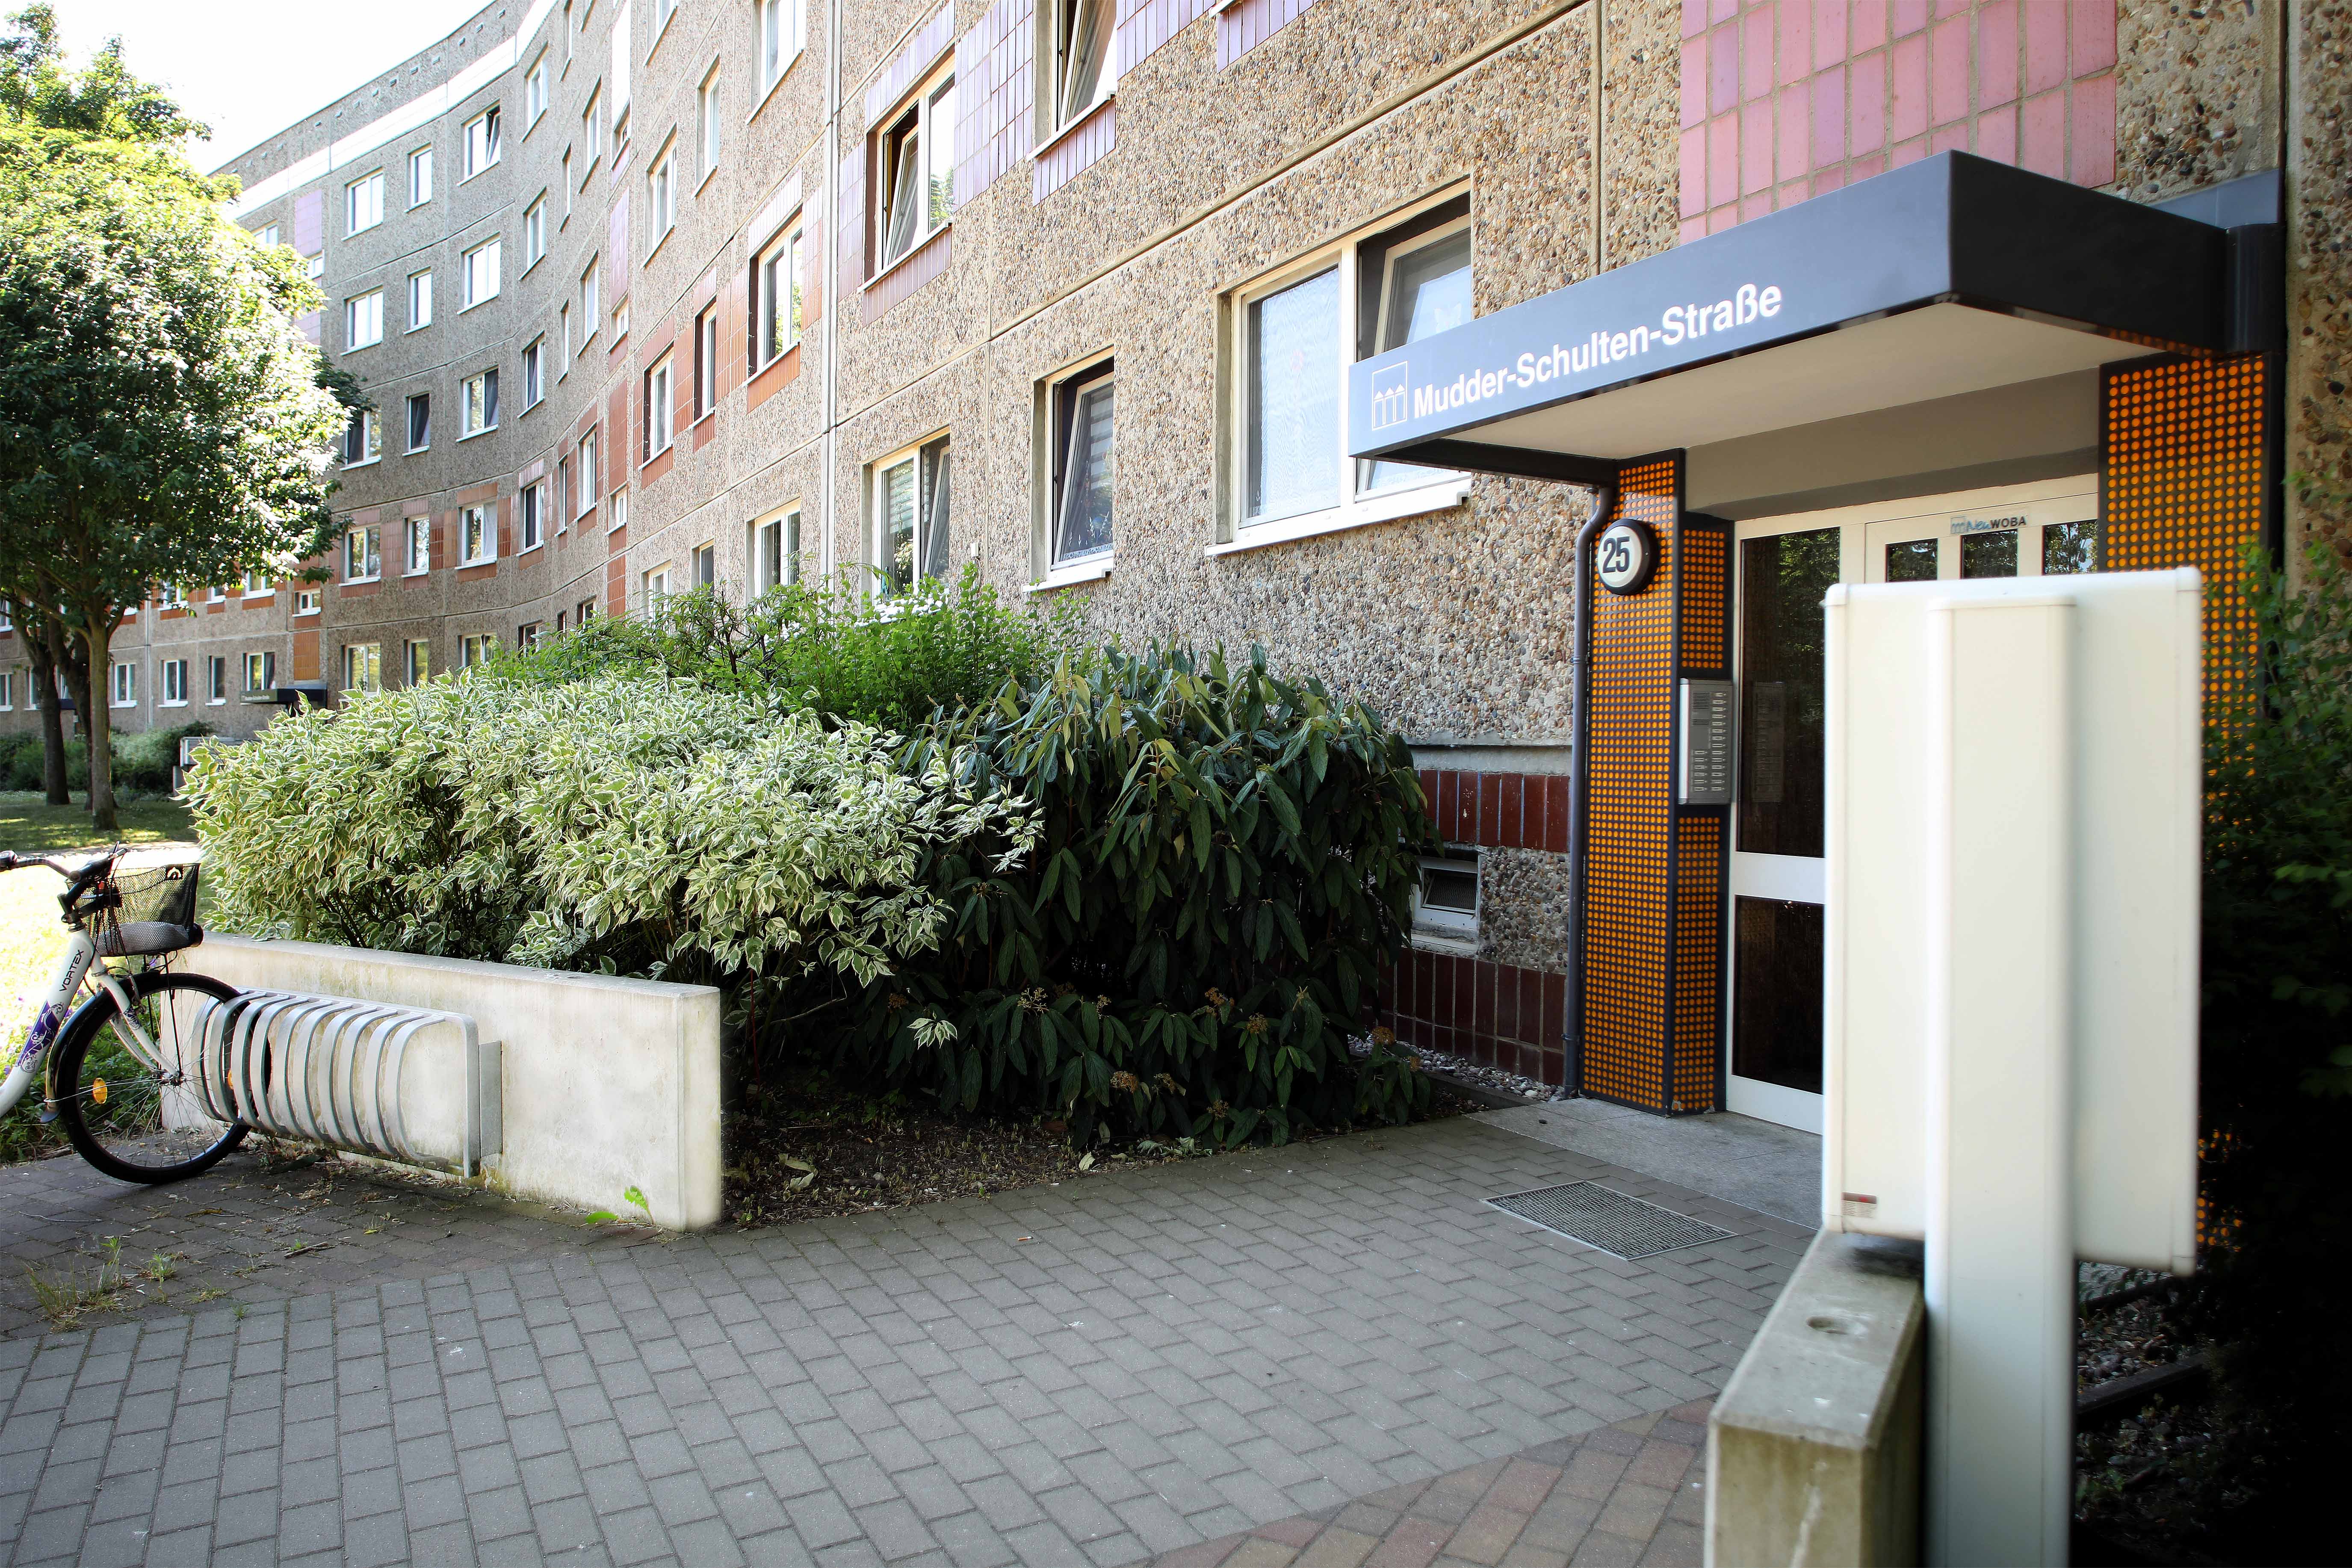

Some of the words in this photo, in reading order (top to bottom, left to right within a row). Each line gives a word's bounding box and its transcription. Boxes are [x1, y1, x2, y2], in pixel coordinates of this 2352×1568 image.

[1413, 283, 1782, 418] Mudder-Schulten-Straße
[1602, 536, 1630, 573] 25
[59, 950, 84, 991] VORTEX
